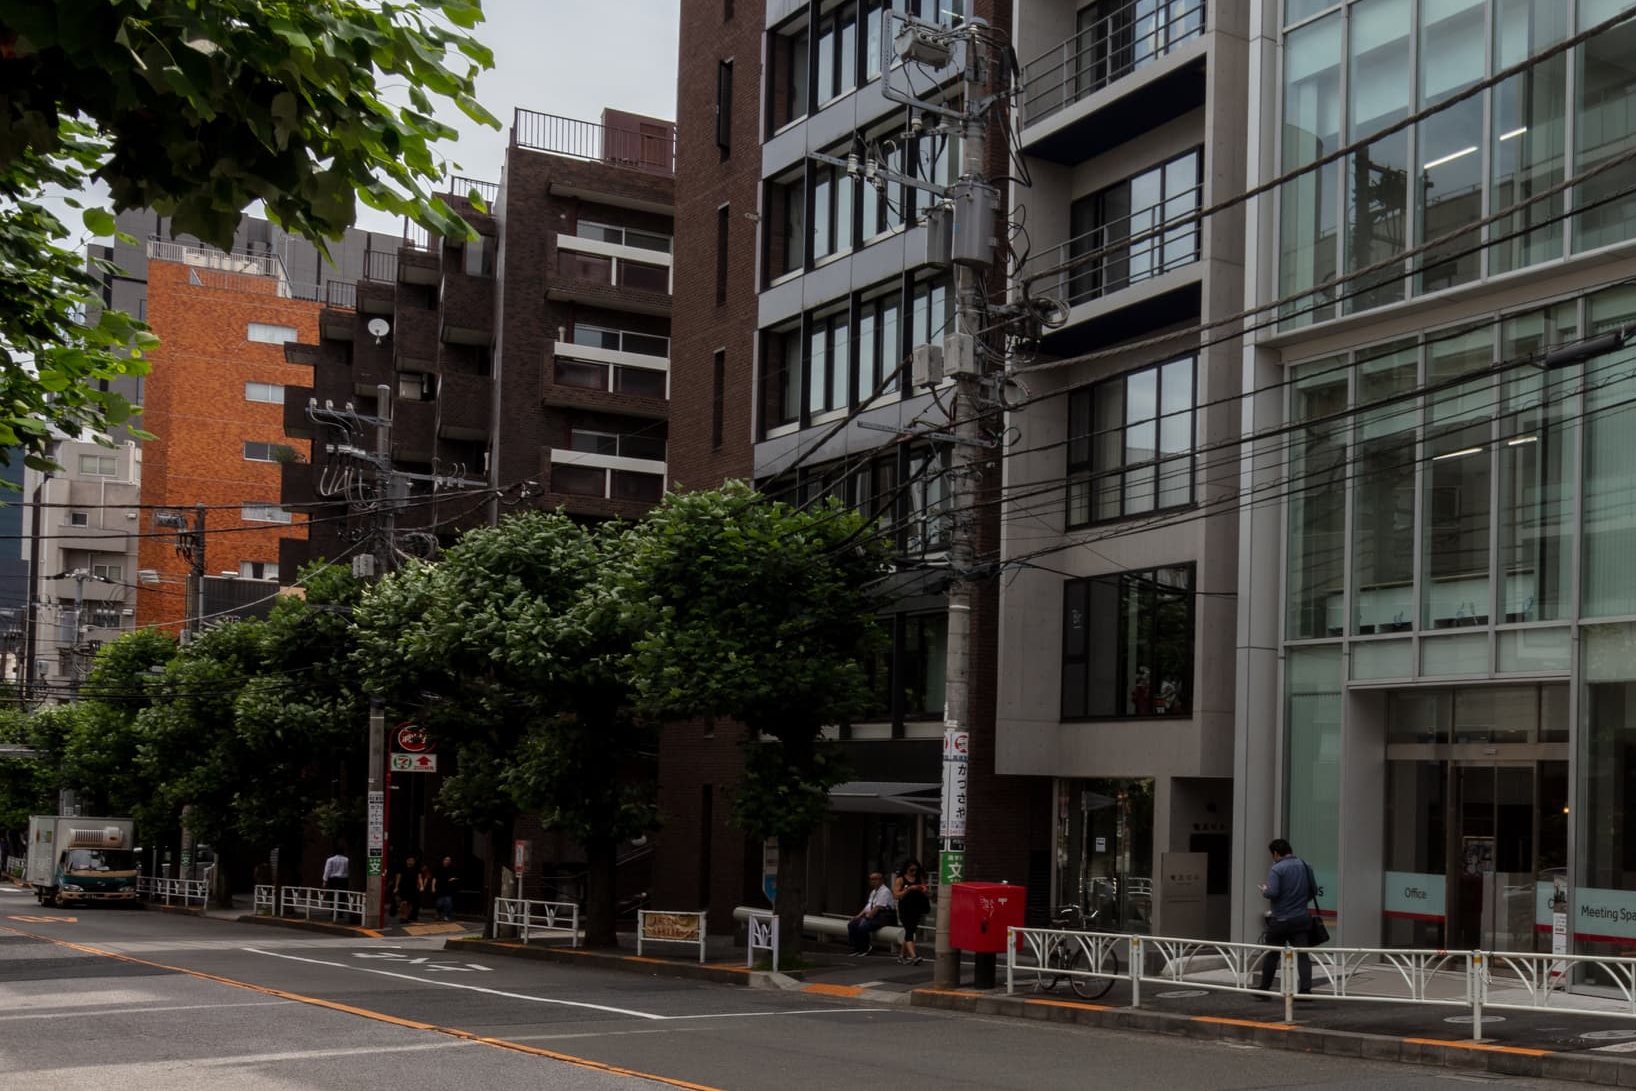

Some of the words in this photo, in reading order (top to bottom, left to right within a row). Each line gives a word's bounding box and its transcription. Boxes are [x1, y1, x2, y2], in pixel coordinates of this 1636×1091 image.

[369, 862, 381, 872] 文
[947, 862, 963, 880] 文
[1404, 887, 1427, 899] Office
[1581, 904, 1618, 922] Meeting
